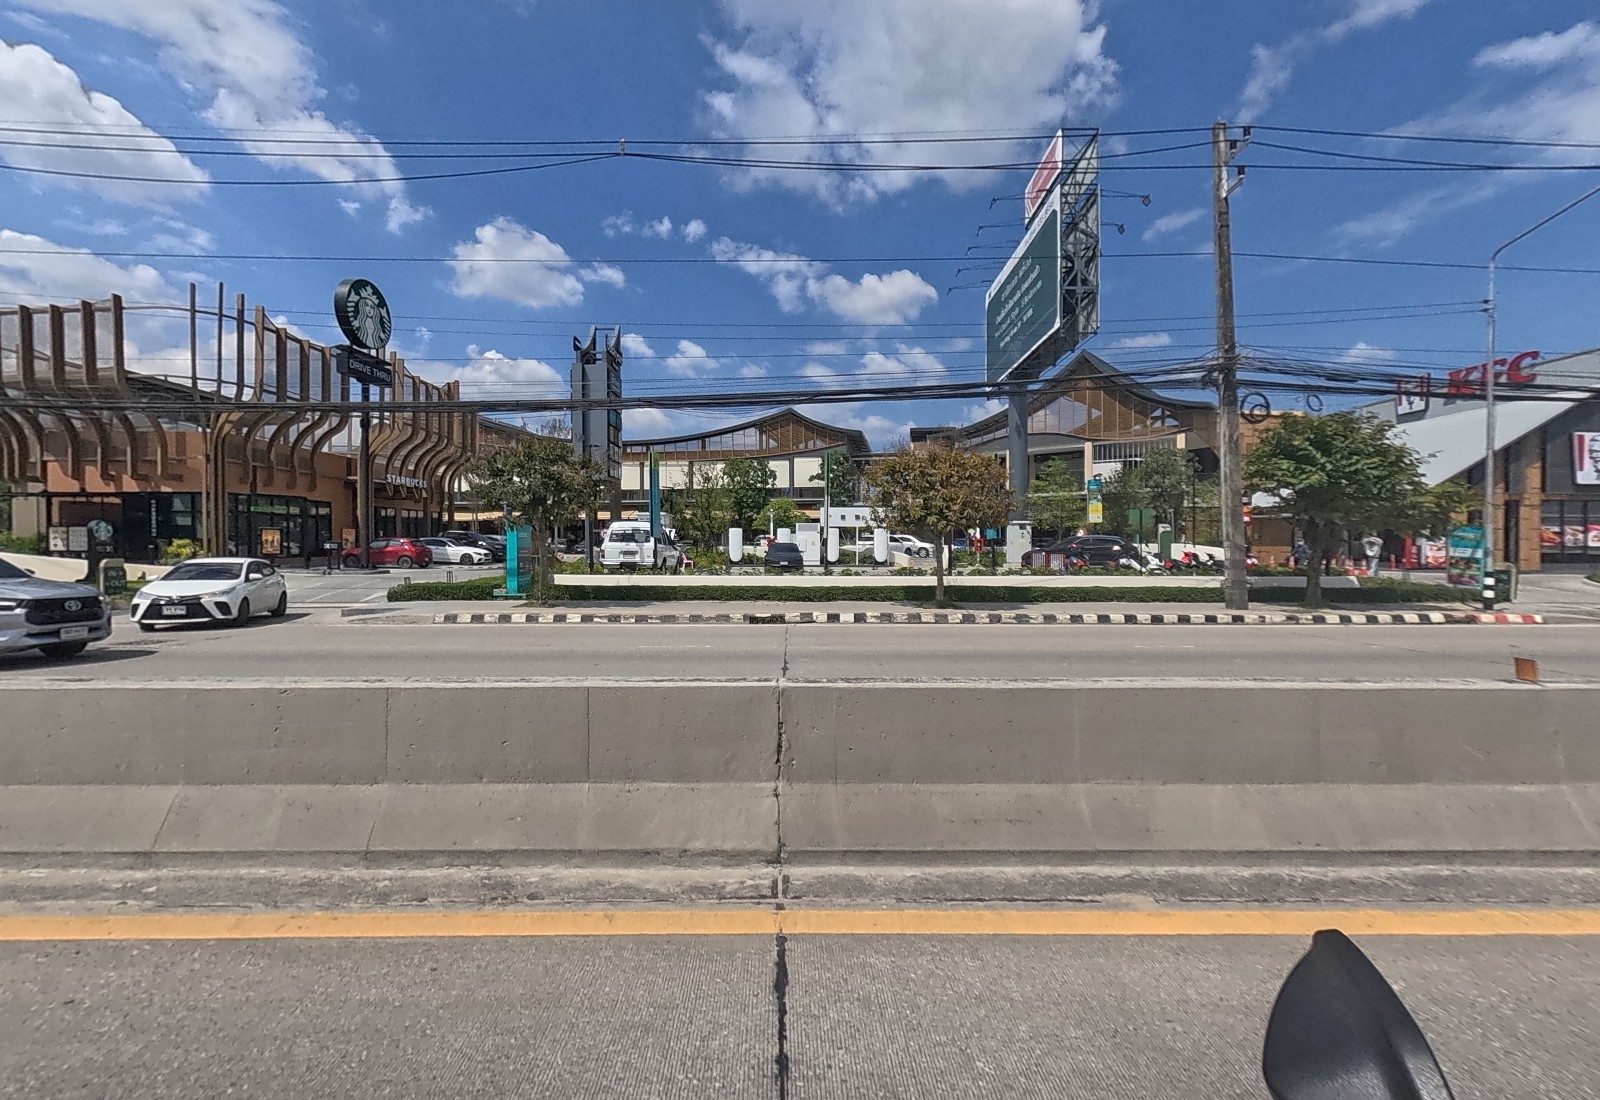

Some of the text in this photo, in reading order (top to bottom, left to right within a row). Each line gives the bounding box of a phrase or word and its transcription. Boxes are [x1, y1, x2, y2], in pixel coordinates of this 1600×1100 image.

[350, 359, 391, 382] DRIVE THRU
[1448, 351, 1540, 395] KFC
[386, 474, 427, 488] STARBUCKS
